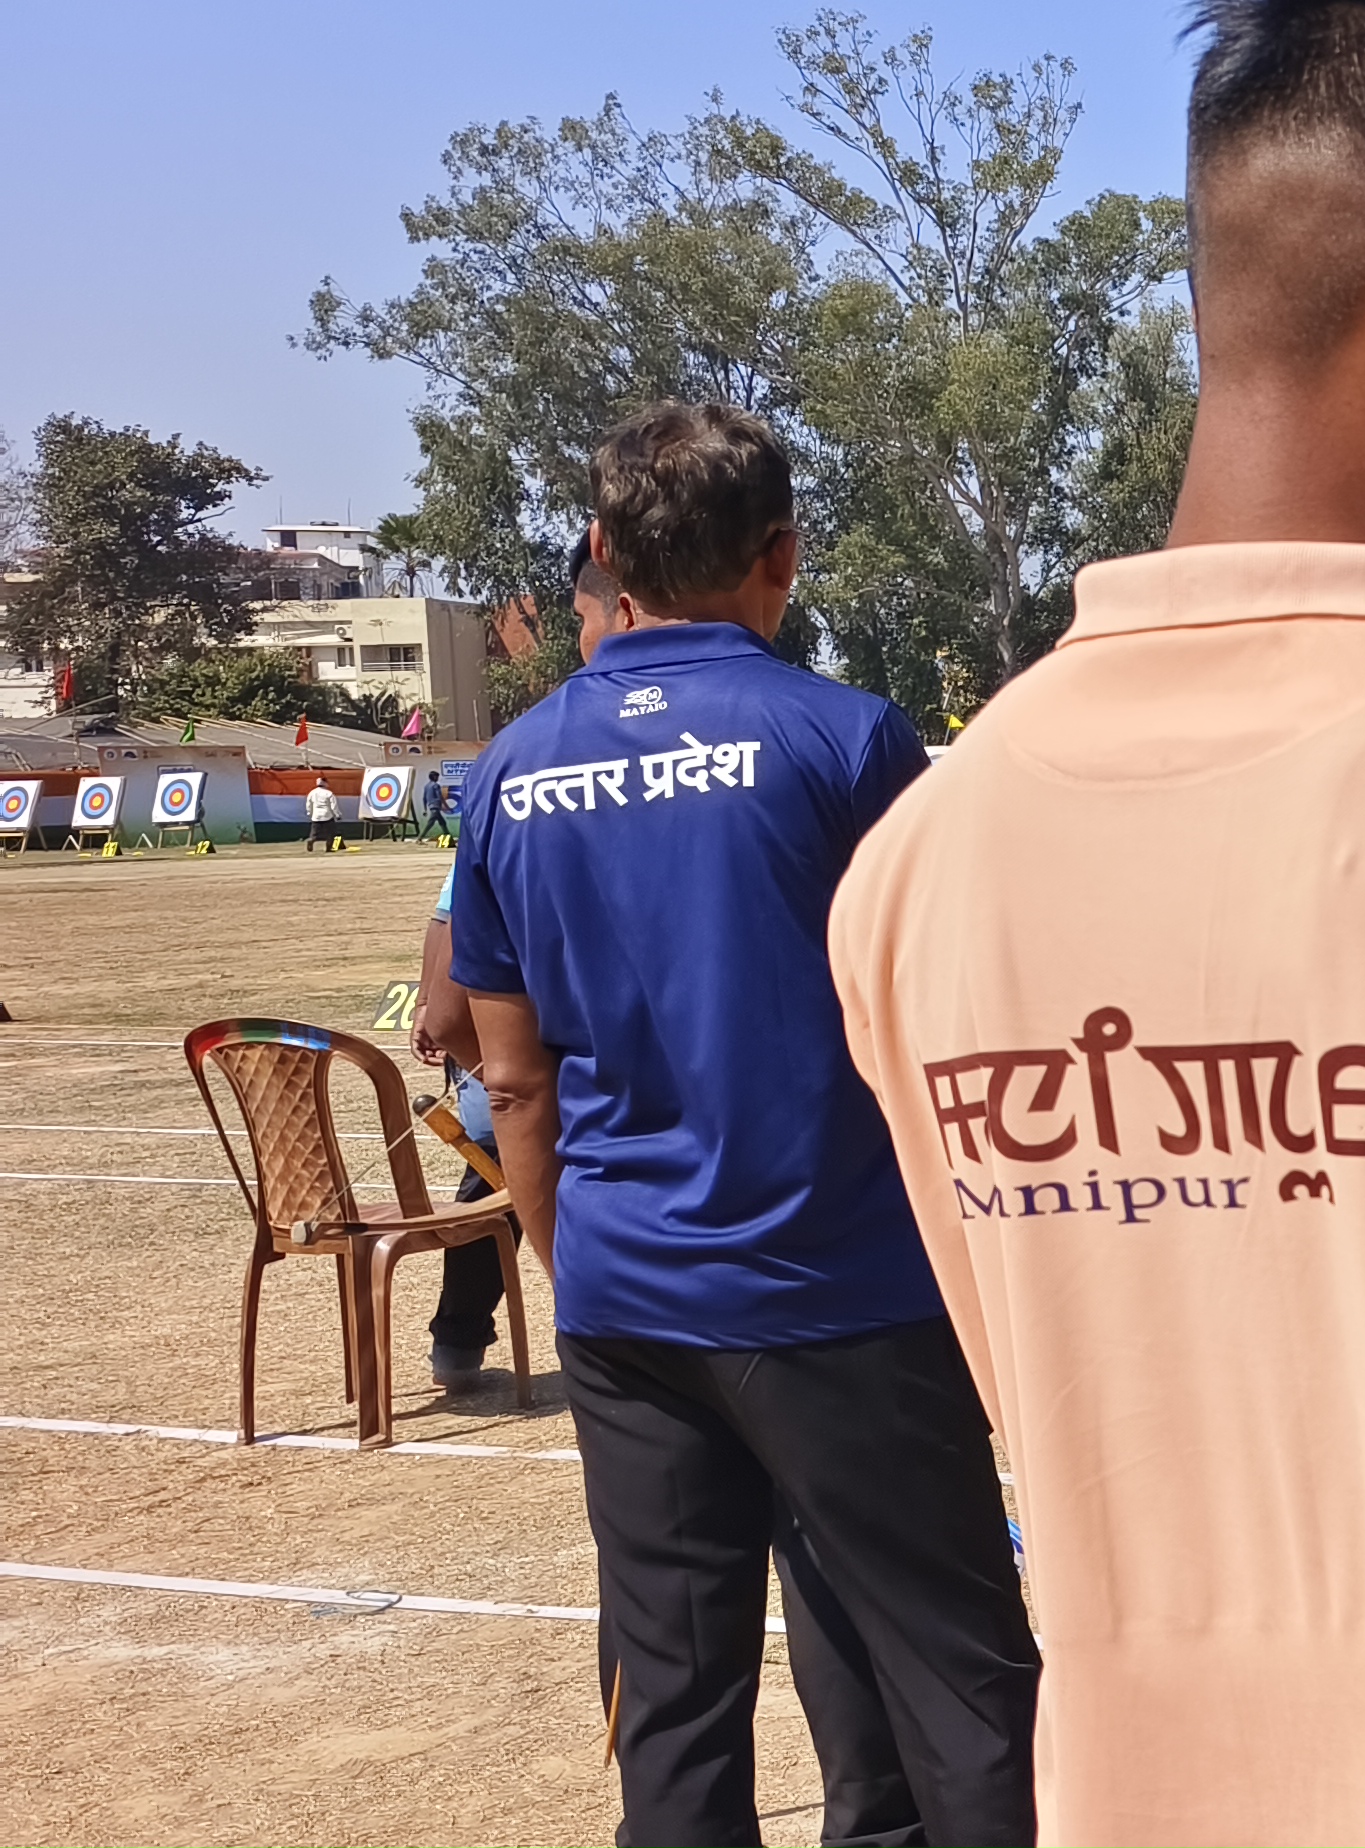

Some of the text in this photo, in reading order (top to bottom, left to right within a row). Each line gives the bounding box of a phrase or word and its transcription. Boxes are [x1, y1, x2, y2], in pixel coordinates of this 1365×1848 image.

[500, 731, 761, 821] उत्तर प्रदेश
[197, 840, 211, 854] 12
[437, 834, 451, 848] 14
